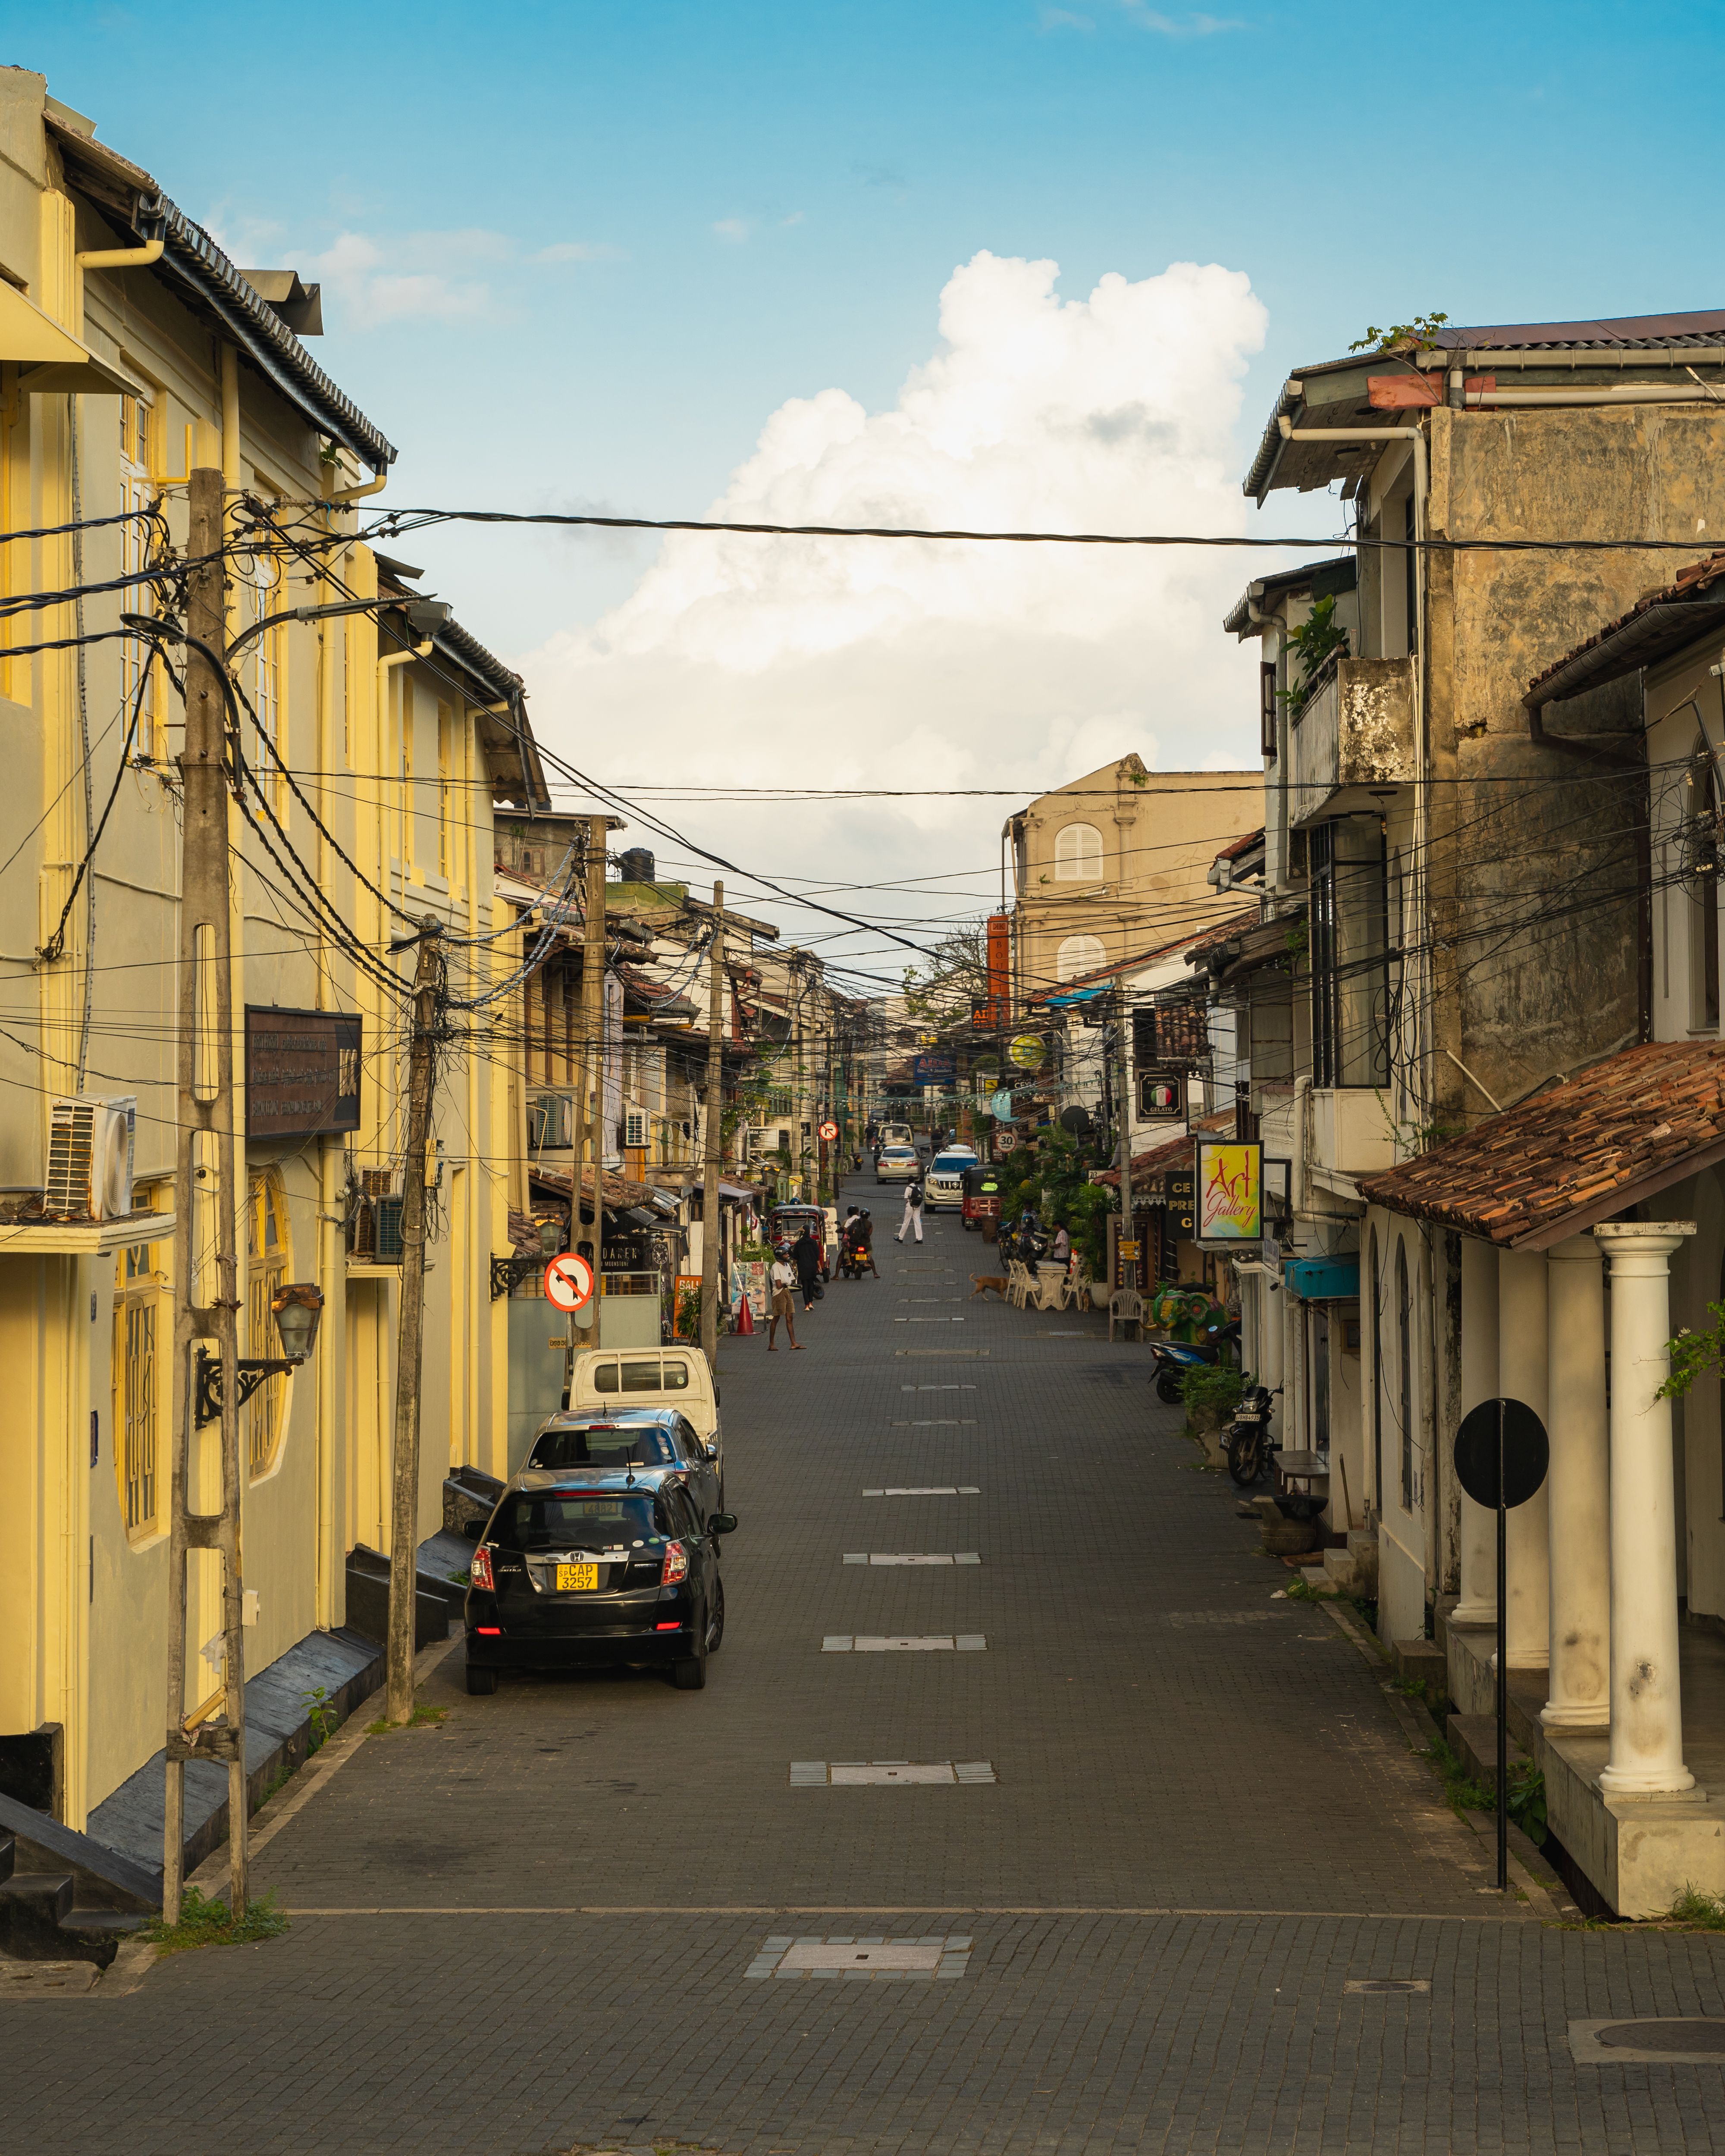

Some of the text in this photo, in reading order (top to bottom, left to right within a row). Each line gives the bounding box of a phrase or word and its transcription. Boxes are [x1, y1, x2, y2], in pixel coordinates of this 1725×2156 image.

[1001, 1136, 1013, 1145] 30
[1206, 1150, 1253, 1198] Art
[1172, 1182, 1194, 1193] CE
[1203, 1191, 1257, 1228] Gallery
[1181, 1218, 1192, 1228] G
[569, 1564, 593, 1576] CAP
[562, 1577, 593, 1589] 3257
